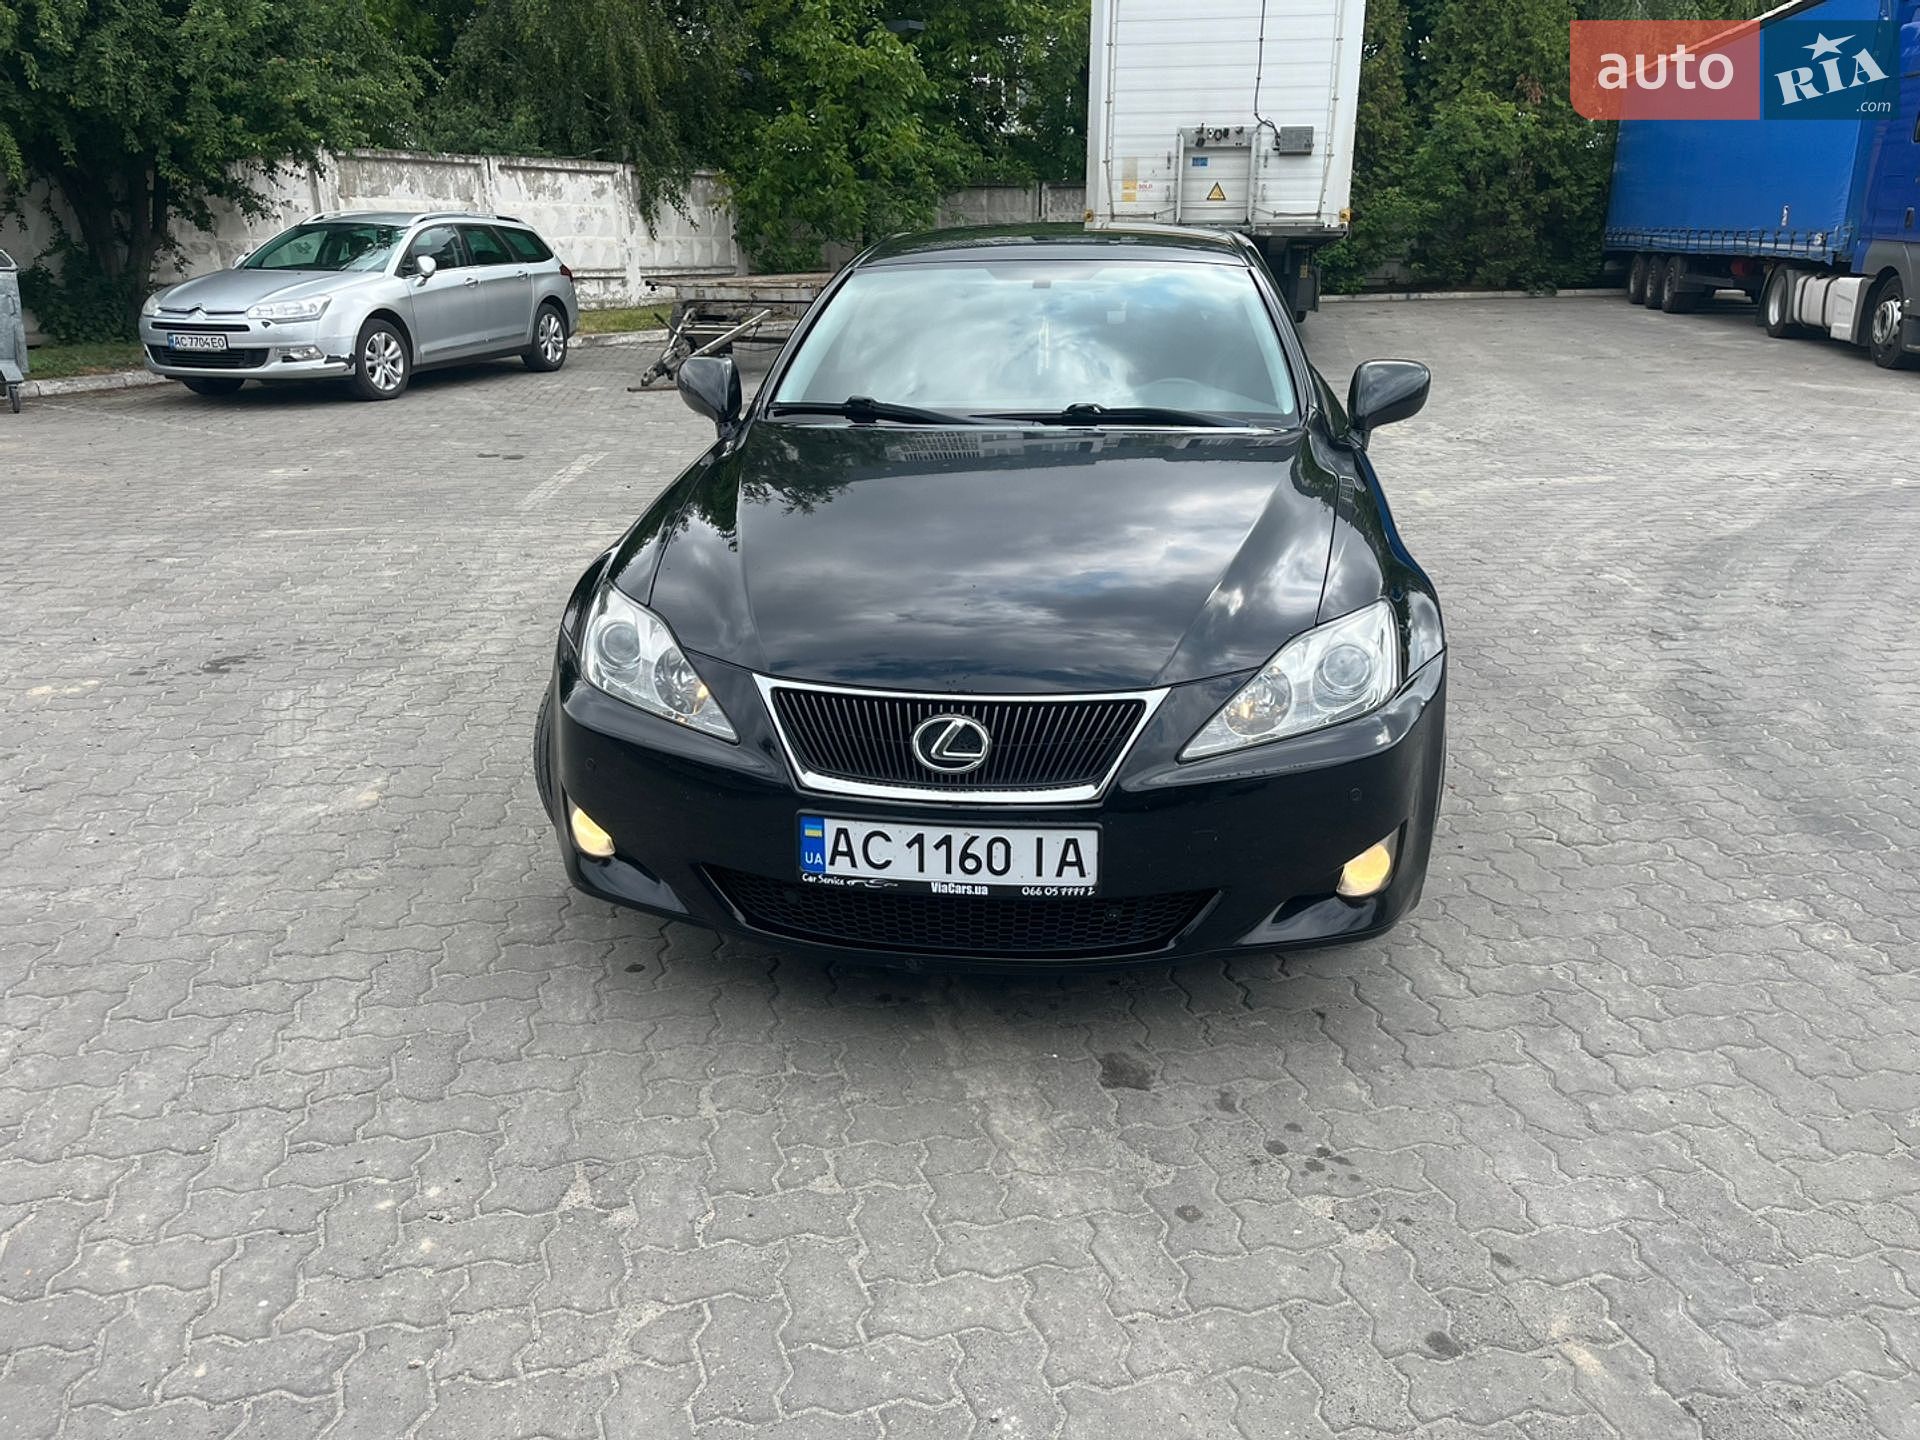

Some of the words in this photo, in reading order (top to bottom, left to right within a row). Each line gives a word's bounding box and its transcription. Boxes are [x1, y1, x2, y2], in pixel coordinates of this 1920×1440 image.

[804, 851, 823, 865] UA
[828, 827, 893, 870] AC
[905, 832, 1012, 876] 1160
[1035, 836, 1087, 878] IA
[802, 873, 817, 883] Car
[818, 873, 844, 886] Service
[930, 881, 989, 896] ViaCars.ua
